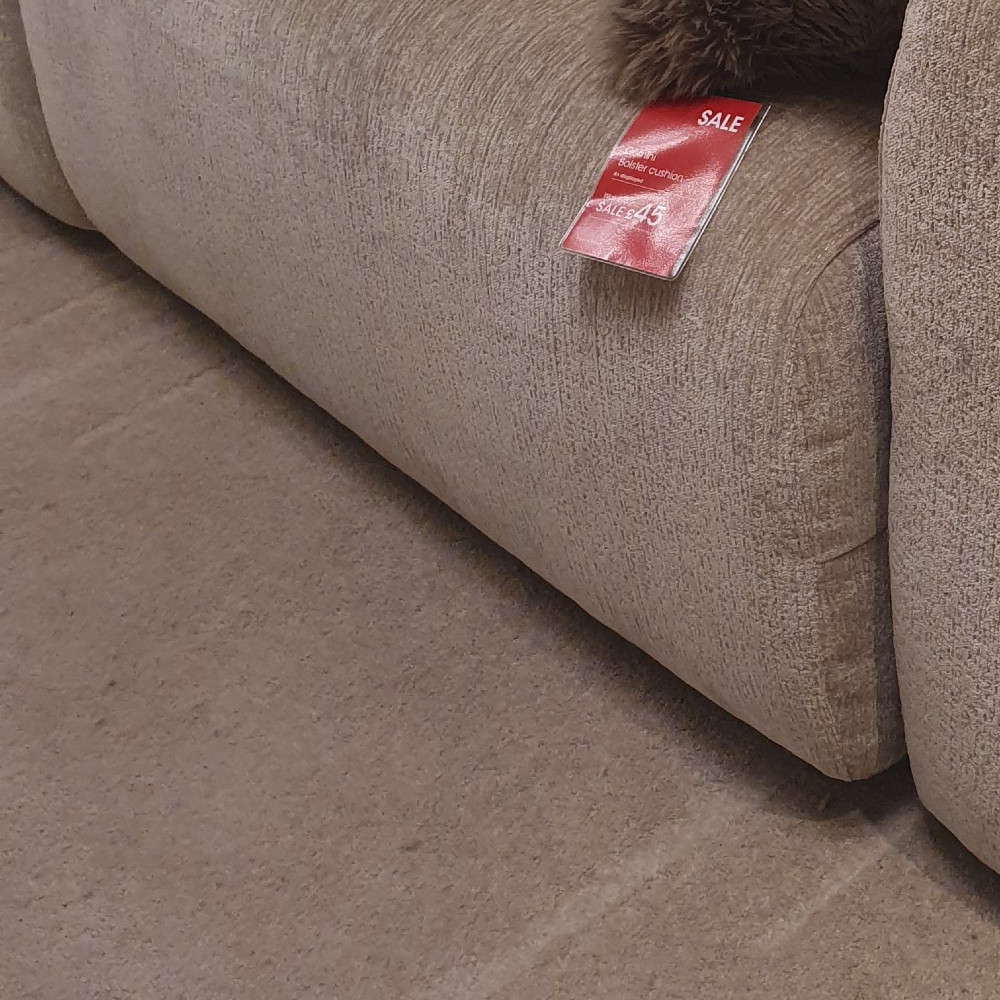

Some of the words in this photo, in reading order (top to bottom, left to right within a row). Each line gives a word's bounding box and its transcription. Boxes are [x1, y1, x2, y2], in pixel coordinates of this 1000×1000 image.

[697, 109, 745, 133] SALE
[618, 157, 648, 173] Bolster
[648, 167, 684, 183] cushion
[596, 200, 626, 217] SALE
[624, 203, 667, 226] £45
